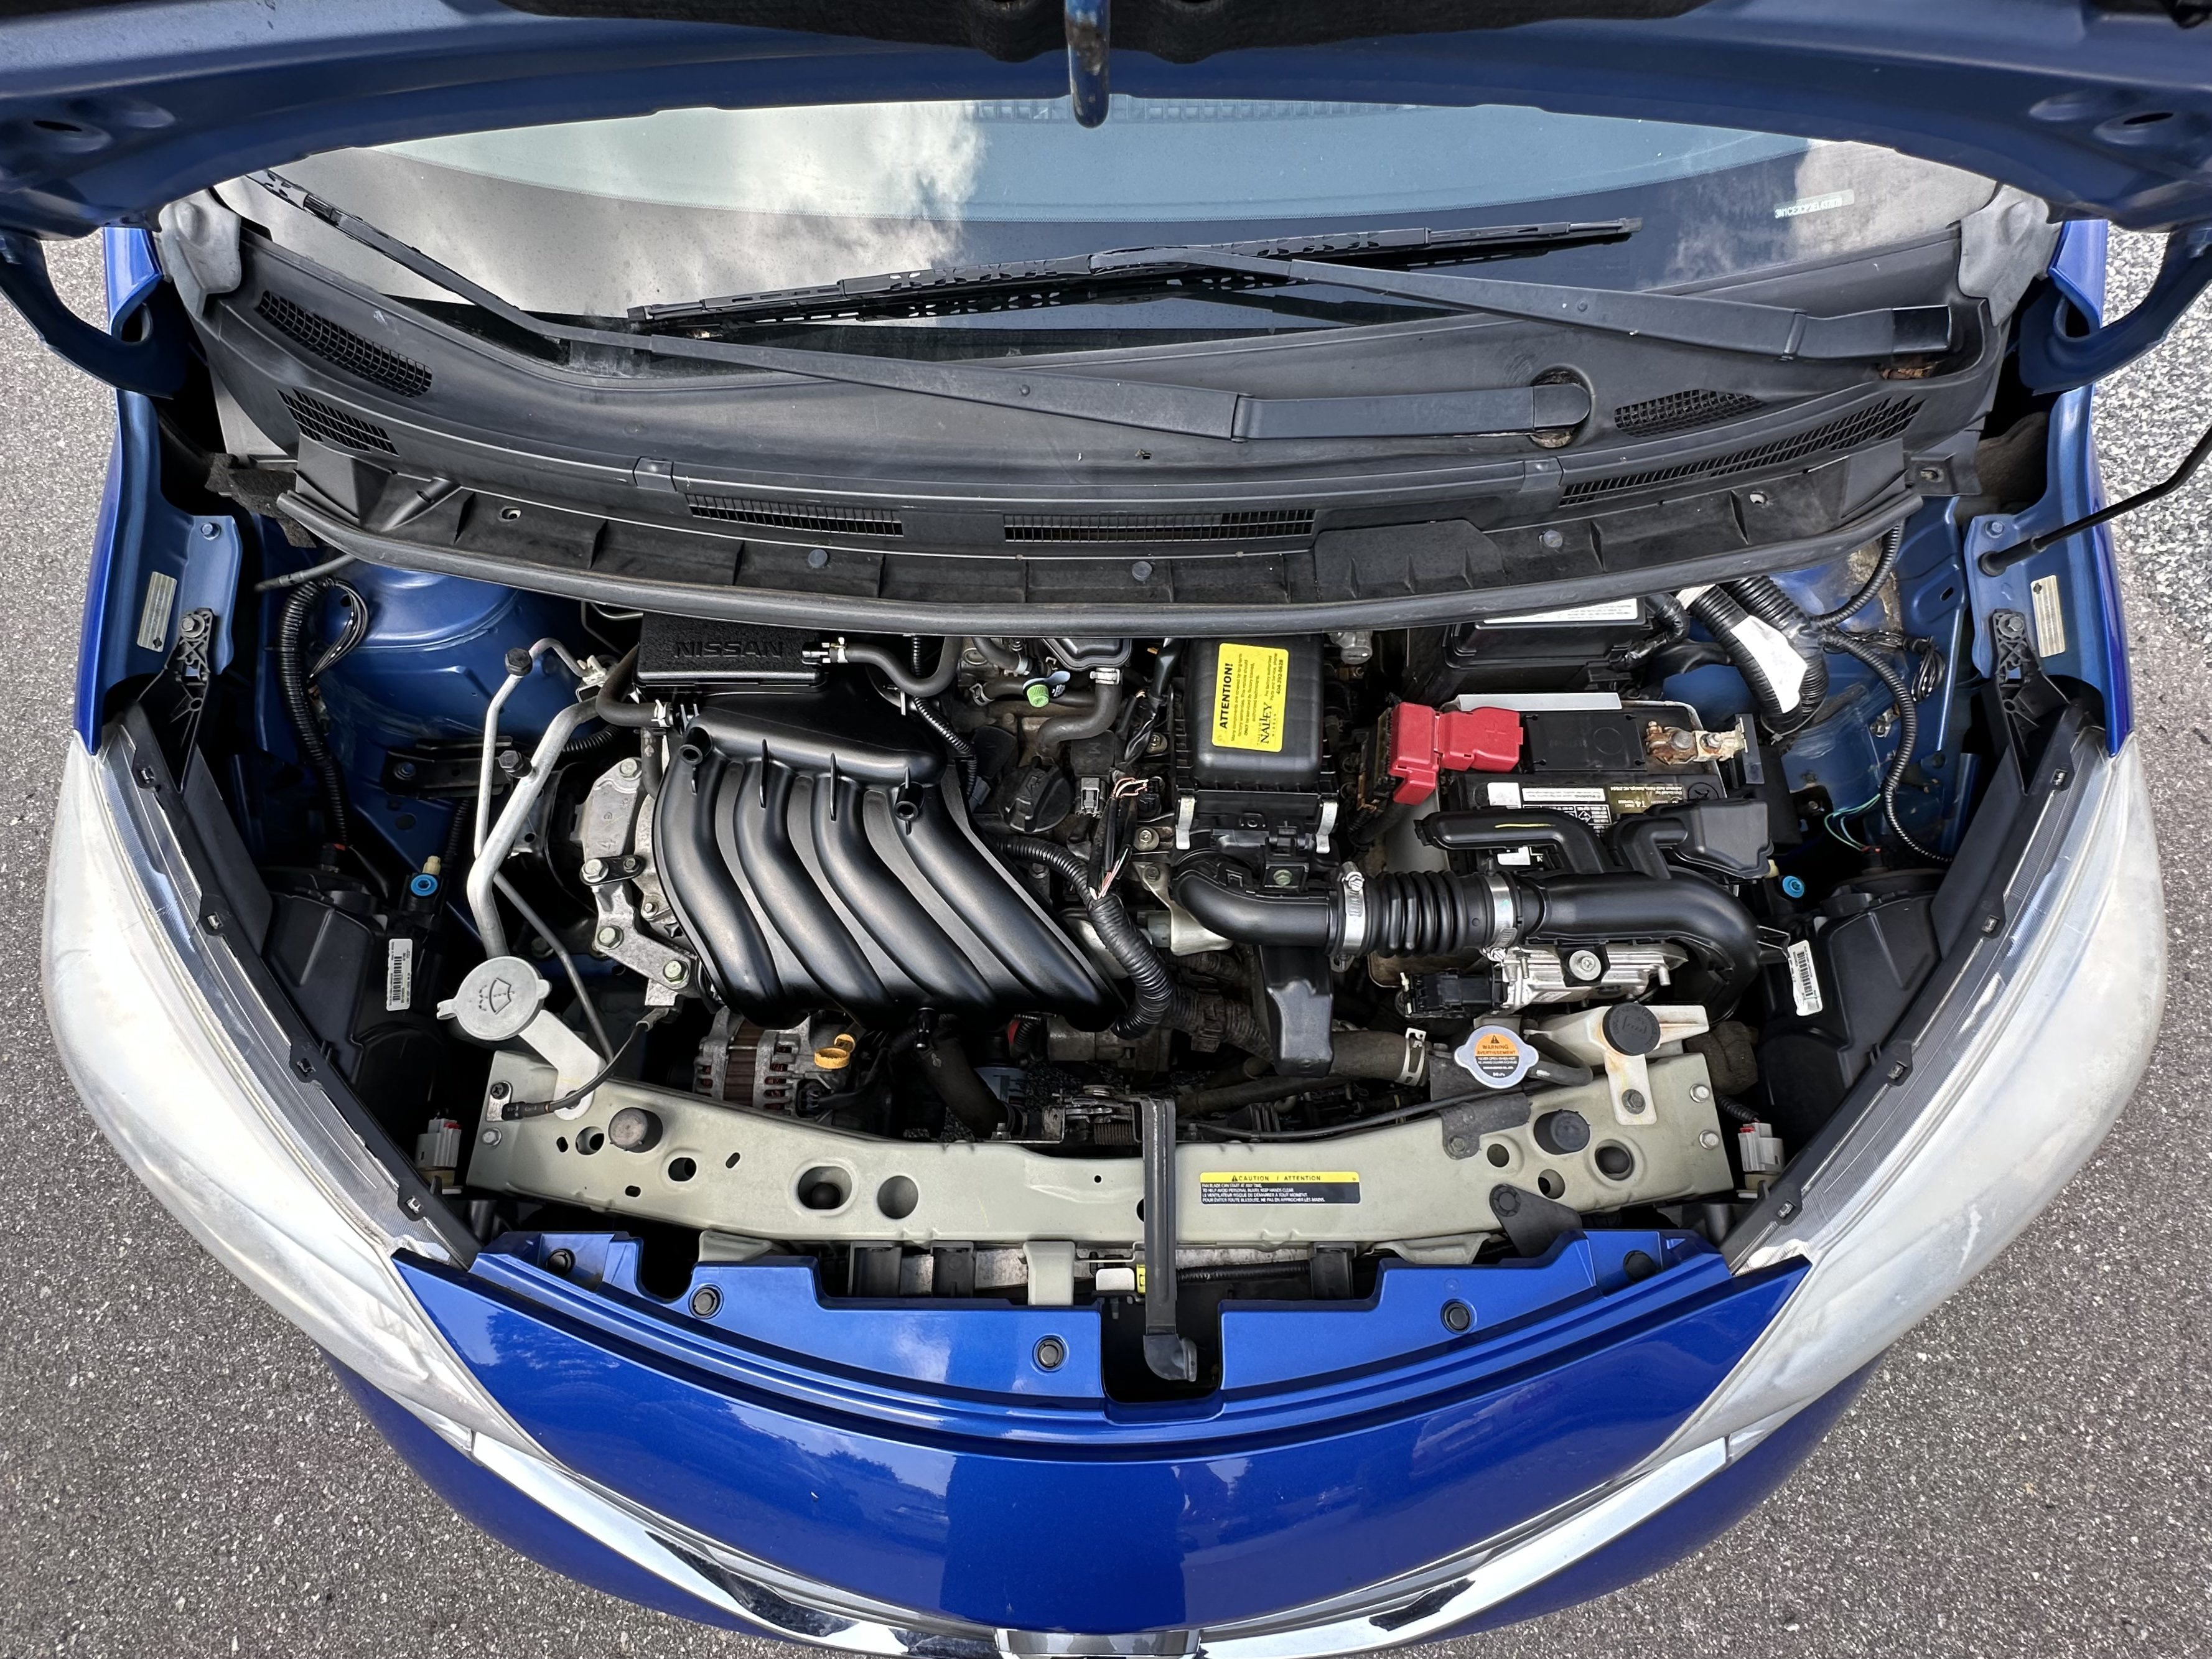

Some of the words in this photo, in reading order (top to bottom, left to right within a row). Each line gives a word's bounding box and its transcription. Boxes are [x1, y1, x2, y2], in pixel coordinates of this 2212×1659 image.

[674, 641, 783, 657] NISSAN
[1220, 663, 1233, 729] ATTENTION!
[1259, 702, 1272, 744] NALLEY
